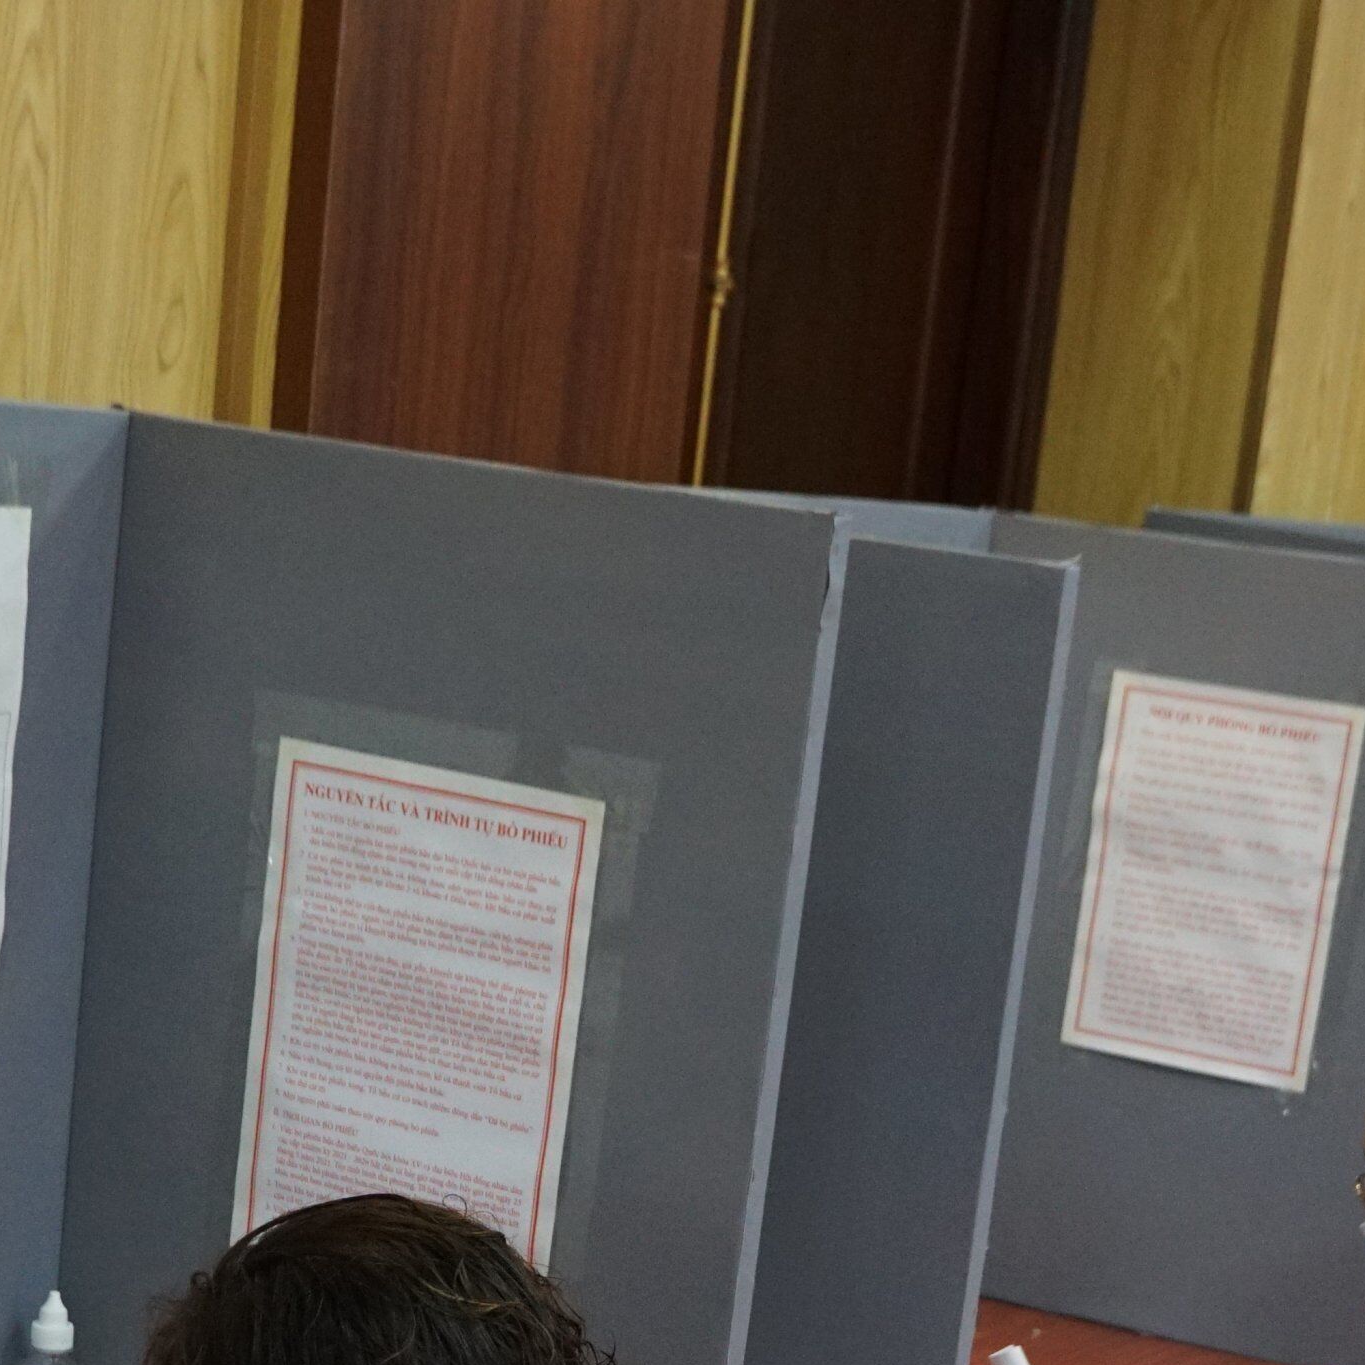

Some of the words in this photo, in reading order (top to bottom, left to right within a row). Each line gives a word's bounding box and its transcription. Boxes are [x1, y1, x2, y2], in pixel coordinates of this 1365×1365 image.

[304, 780, 364, 807] NGUYÊN
[367, 788, 397, 814] TẮC
[400, 798, 420, 818] VÀ
[424, 802, 471, 829] TRÌNH
[472, 816, 494, 838] TỰ
[496, 818, 519, 839] BỎ
[521, 824, 569, 850] PHIẾU
